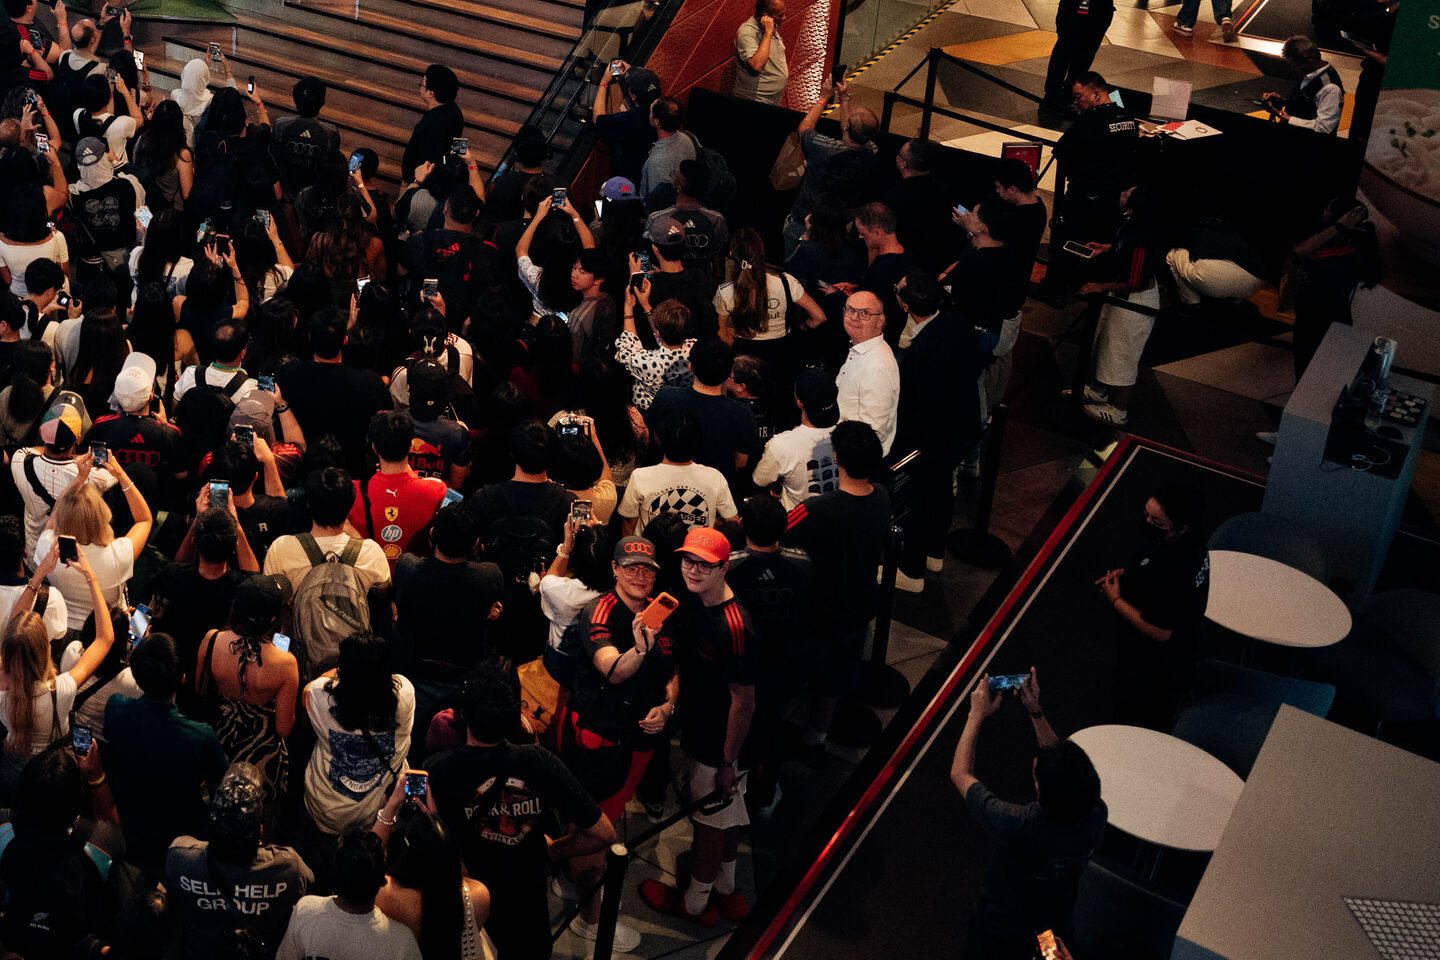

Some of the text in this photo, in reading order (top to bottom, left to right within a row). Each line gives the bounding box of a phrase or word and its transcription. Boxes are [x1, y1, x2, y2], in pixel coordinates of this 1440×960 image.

[1109, 121, 1135, 132] SECURITY
[417, 458, 443, 471] Bull
[512, 797, 541, 816] ROLL
[180, 876, 287, 898] SEL HELP
